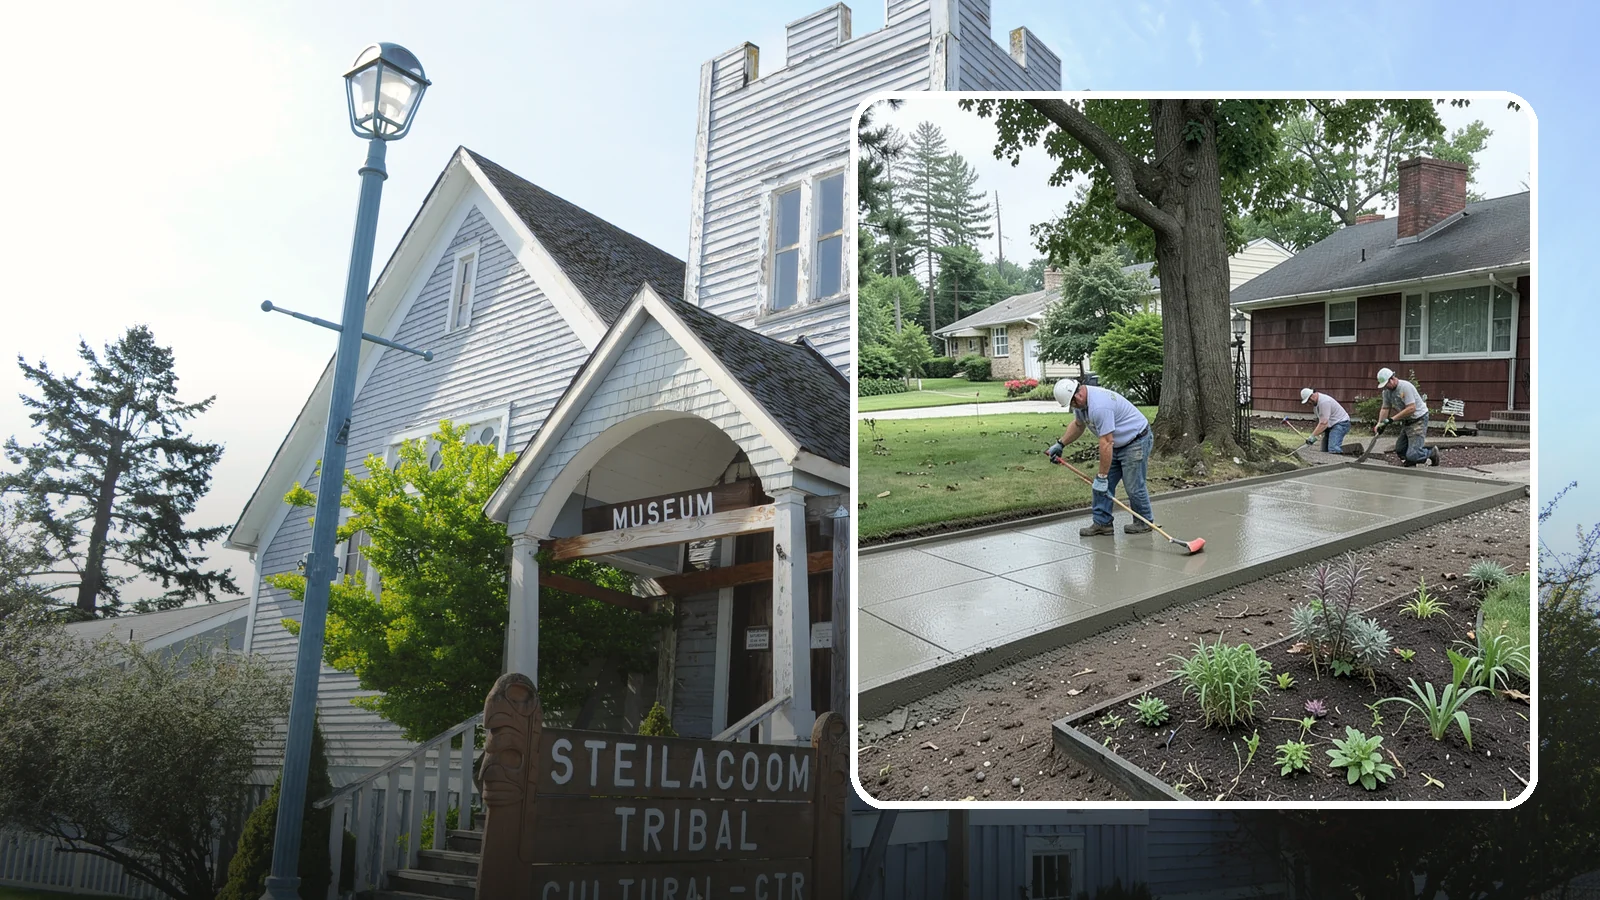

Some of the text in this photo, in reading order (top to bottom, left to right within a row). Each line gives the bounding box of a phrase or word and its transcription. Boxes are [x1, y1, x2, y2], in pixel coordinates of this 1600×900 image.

[613, 491, 713, 531] MUSEUM
[550, 738, 809, 792] STEILACOOM
[615, 806, 758, 852] TRIBAL
